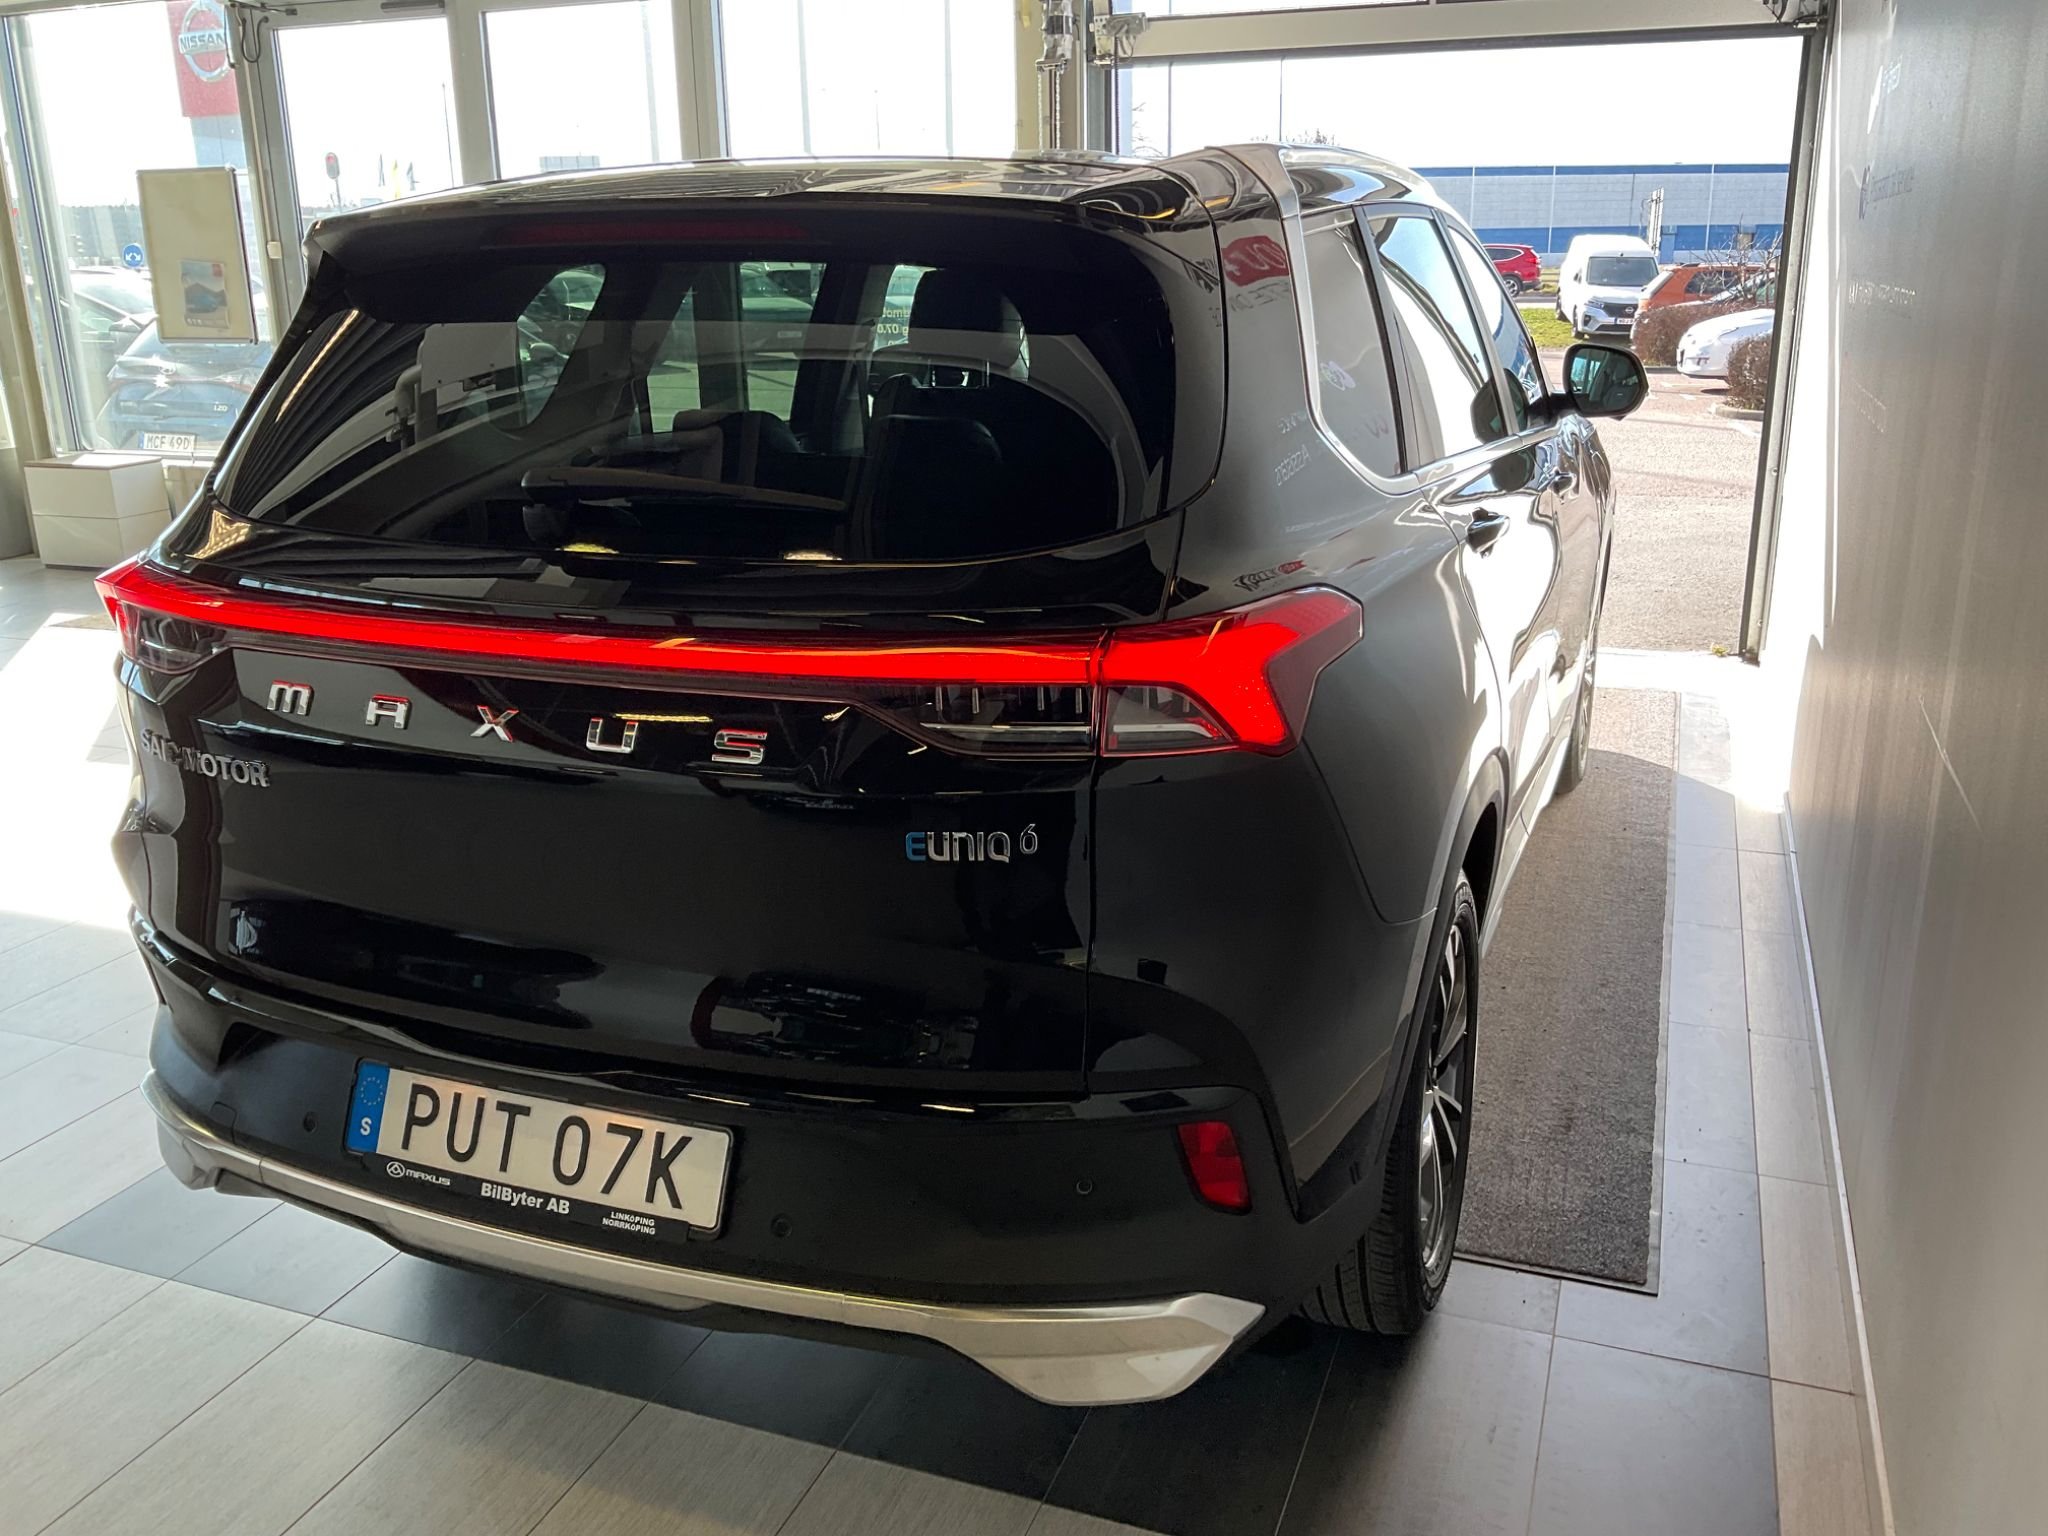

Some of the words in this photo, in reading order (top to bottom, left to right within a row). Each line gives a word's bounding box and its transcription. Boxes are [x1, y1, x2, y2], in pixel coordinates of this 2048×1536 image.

[180, 33, 224, 49] NISSAN
[146, 435, 166, 449] MCF
[267, 680, 768, 765] MAXUS
[181, 746, 270, 787] MOTOR
[905, 831, 1011, 864] EUNIQ
[1019, 823, 1038, 855] 6
[359, 1116, 373, 1136] S
[400, 1083, 531, 1173] PUT
[552, 1115, 693, 1210] 07K
[405, 1169, 450, 1186] MAXUS
[480, 1182, 544, 1209] BilByter
[546, 1197, 570, 1215] AB
